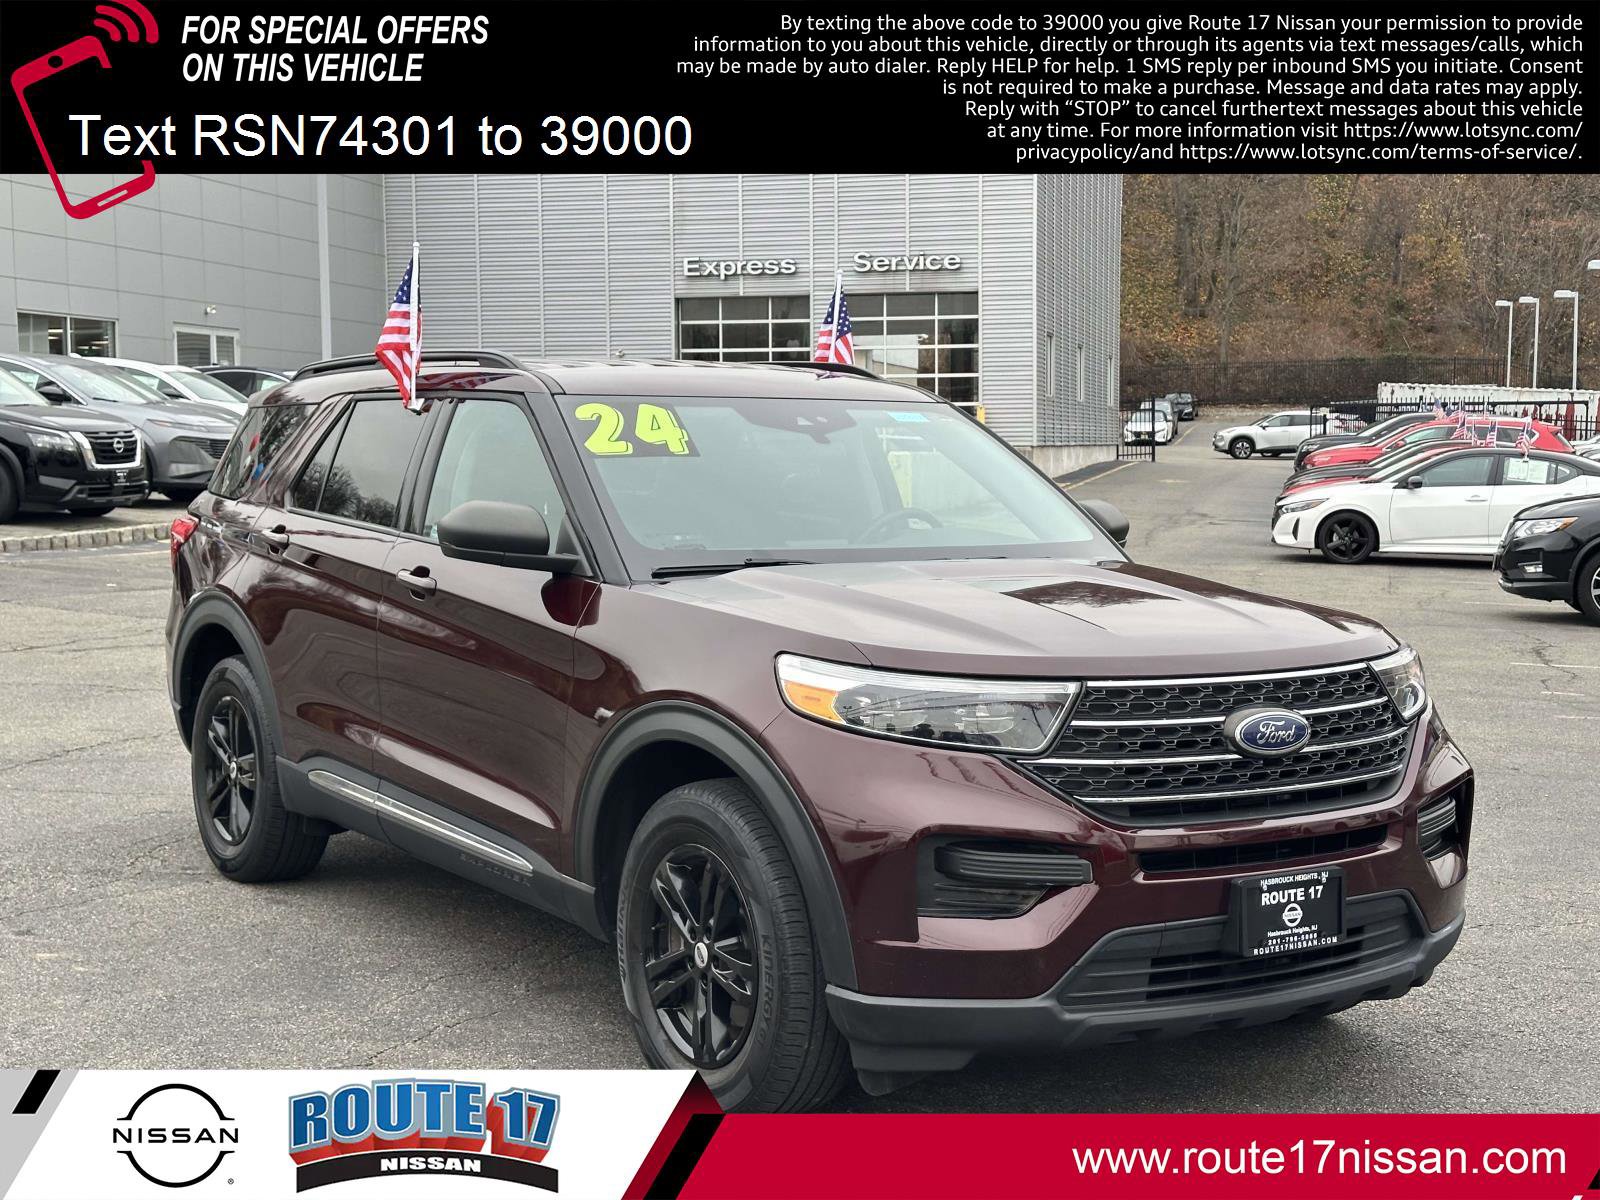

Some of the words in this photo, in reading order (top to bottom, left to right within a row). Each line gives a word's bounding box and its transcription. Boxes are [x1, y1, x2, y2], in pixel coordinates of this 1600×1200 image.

[682, 257, 799, 281] Express
[852, 250, 963, 274] Service
[574, 402, 690, 456] 24
[1256, 720, 1296, 745] Ford
[1260, 876, 1294, 887] HASBROUCK
[1261, 888, 1305, 906] ROUTE
[1308, 885, 1324, 899] 17
[1253, 936, 1338, 956] ROUTE17NISSAN.COM
